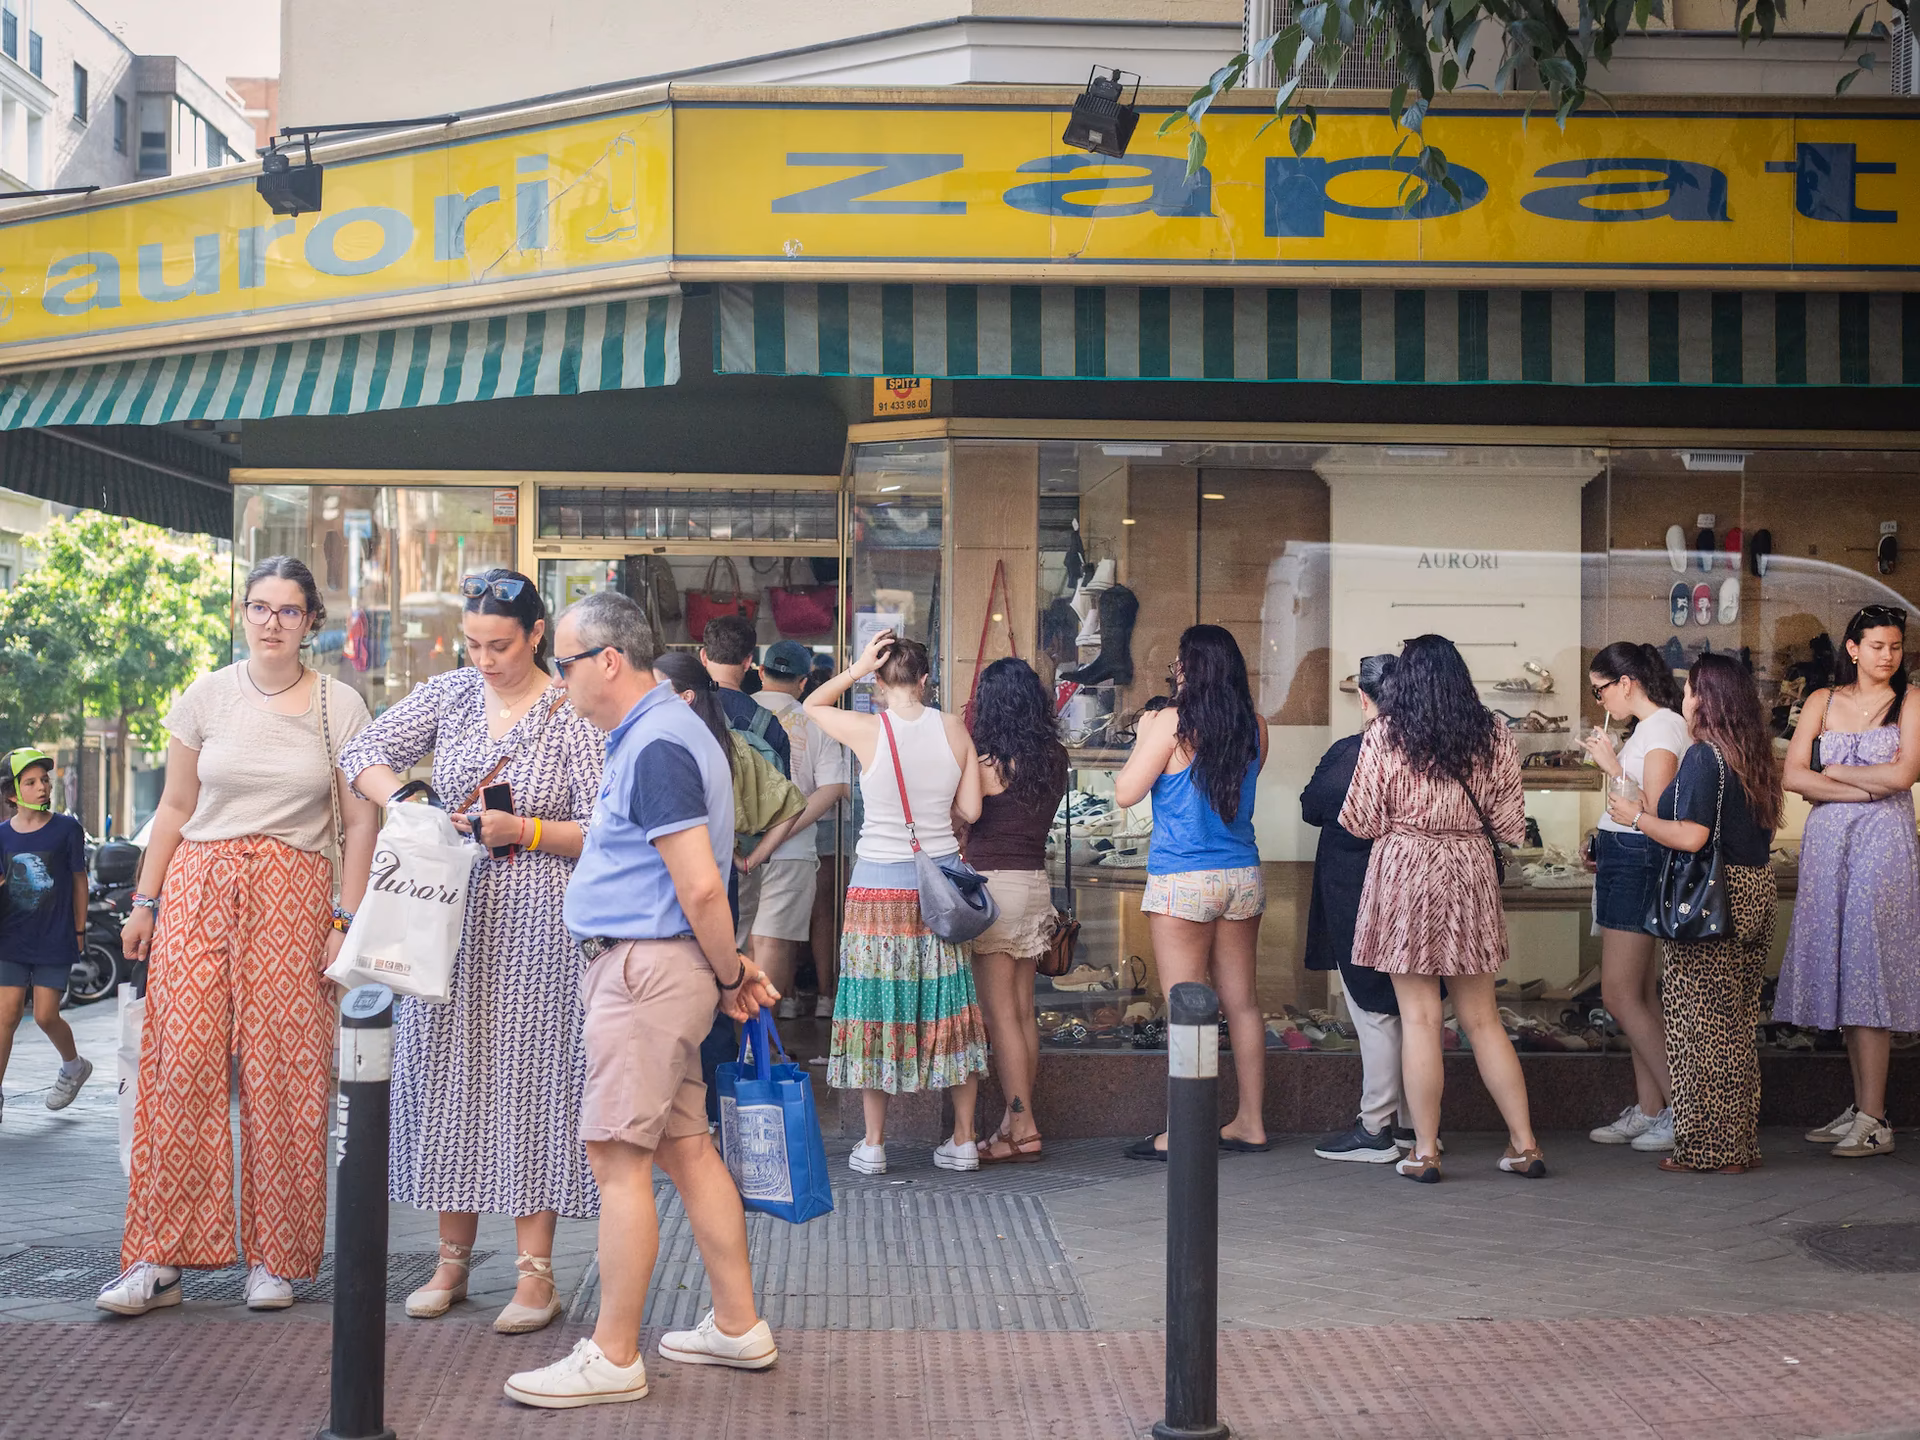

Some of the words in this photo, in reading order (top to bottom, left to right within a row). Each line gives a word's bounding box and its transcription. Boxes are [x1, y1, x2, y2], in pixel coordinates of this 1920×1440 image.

[771, 143, 1898, 238] zapat
[42, 153, 550, 316] aurori
[889, 378, 917, 389] SPITZ
[878, 402, 888, 412] 91
[890, 400, 904, 410] 433
[906, 399, 916, 409] 98
[918, 399, 928, 408] 00
[1417, 552, 1499, 569] AURORI
[369, 850, 459, 905] Aurori
